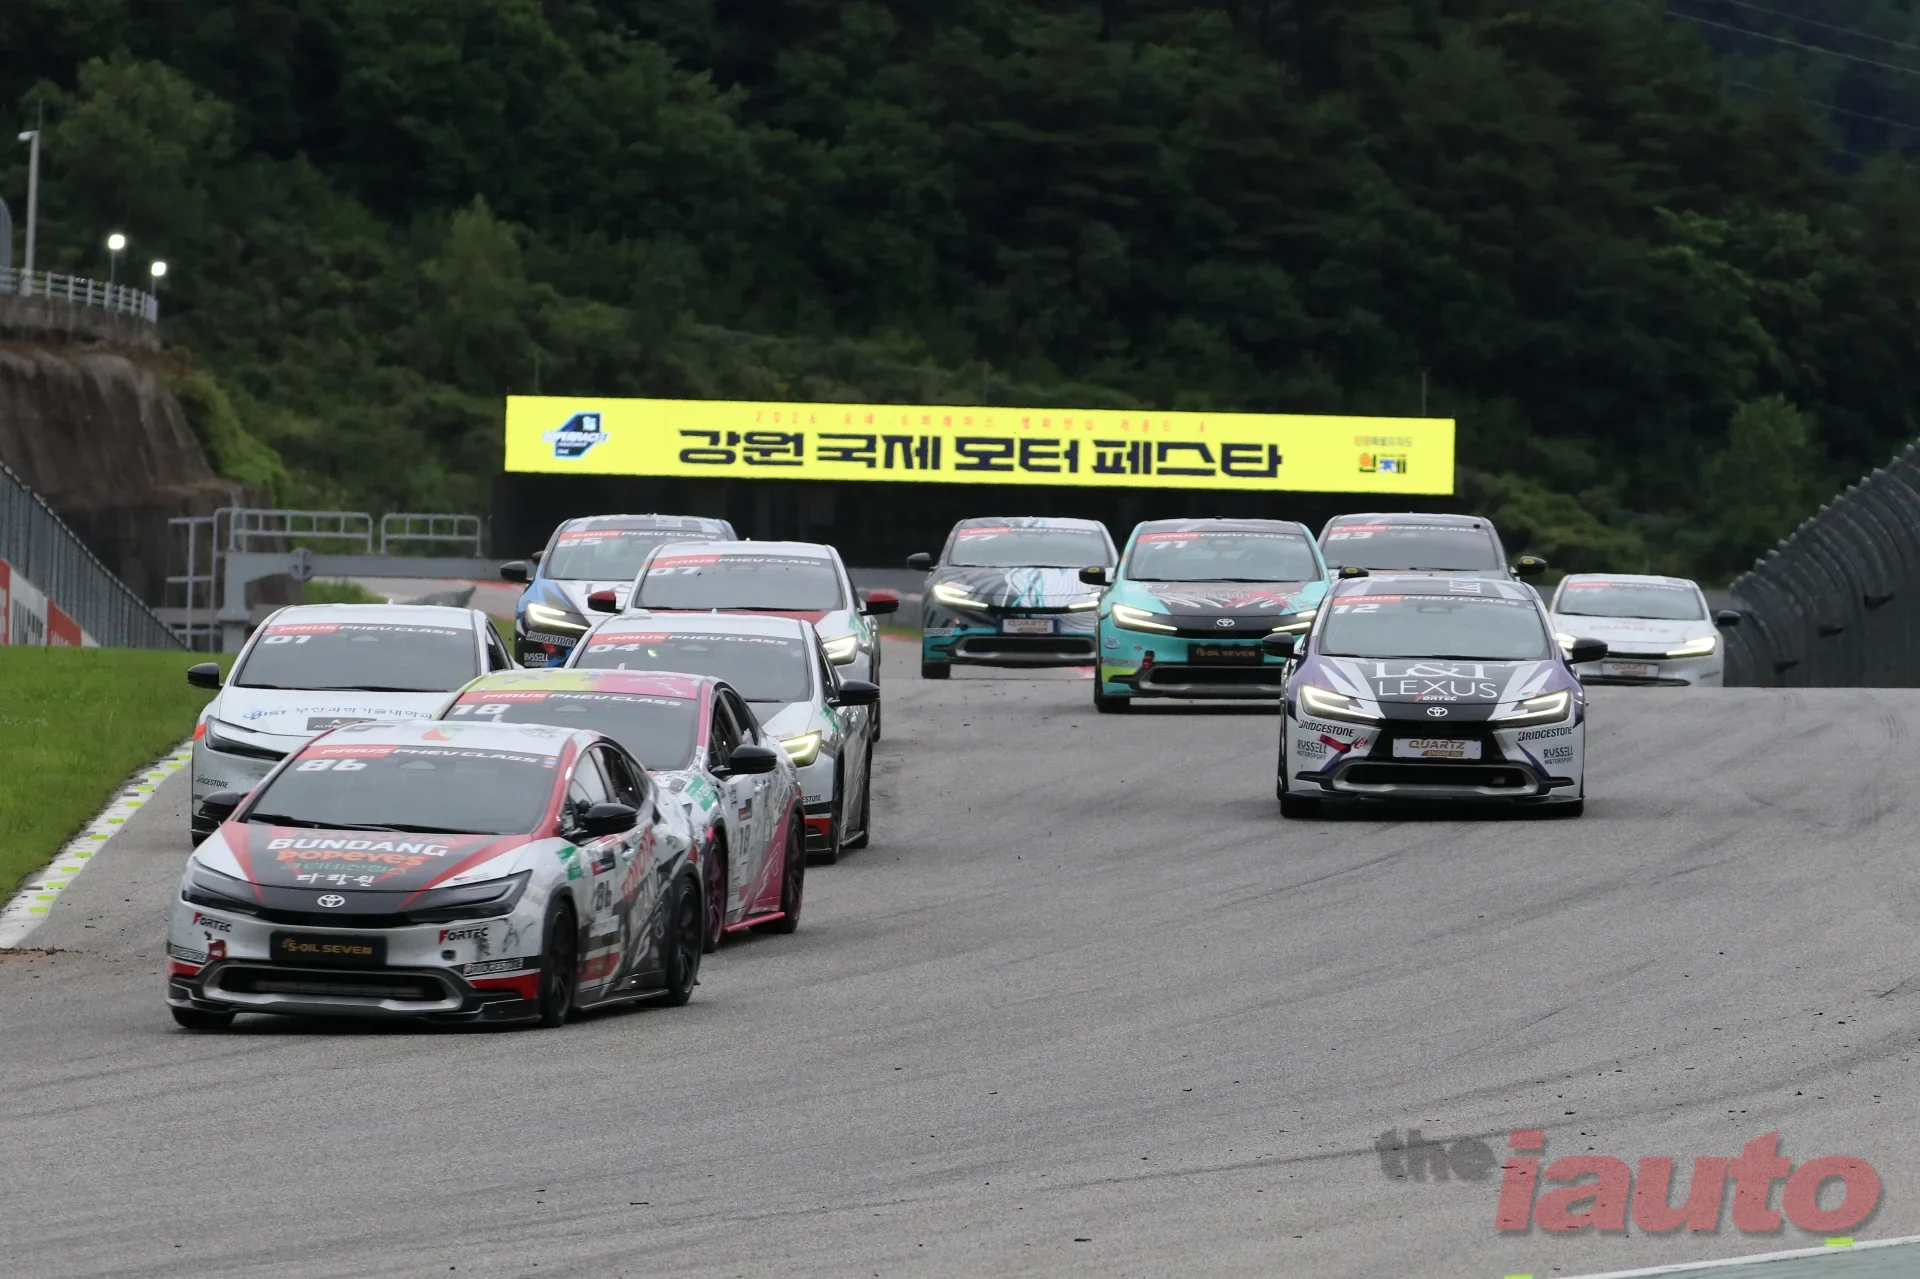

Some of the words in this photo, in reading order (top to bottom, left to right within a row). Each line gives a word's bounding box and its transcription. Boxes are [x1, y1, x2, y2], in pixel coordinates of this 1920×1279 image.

[679, 430, 804, 466] 강원
[817, 433, 941, 471] 국제
[955, 436, 1079, 474] 모터
[1092, 439, 1282, 478] 페스타
[765, 558, 821, 566] CLASS
[648, 566, 702, 577] 07
[1345, 595, 1403, 603] PRIUS
[1334, 603, 1380, 615] 12
[394, 626, 458, 636] CLASS
[263, 635, 312, 644] 01
[724, 636, 789, 645] CLASS
[587, 643, 641, 653] 04
[1379, 680, 1498, 698] LEXUS
[482, 692, 547, 700] PRIUS
[610, 695, 682, 706] CLASS
[1415, 694, 1458, 702] FORTEC
[452, 703, 512, 716] 18
[1298, 719, 1355, 738] BRIDGESTONE
[1517, 726, 1573, 742] BRIDGESTONE
[1298, 739, 1328, 755] RUSSELL
[1408, 740, 1466, 750] QUARTZ
[393, 749, 460, 757] PHEV
[461, 752, 539, 763] CLASS
[1543, 746, 1574, 758] RUSSELL
[296, 759, 367, 771] 86
[267, 838, 450, 857] BUNDANG
[193, 911, 233, 933] FORTEC
[438, 927, 489, 945] FORTEC
[322, 944, 373, 955] SEVEN
